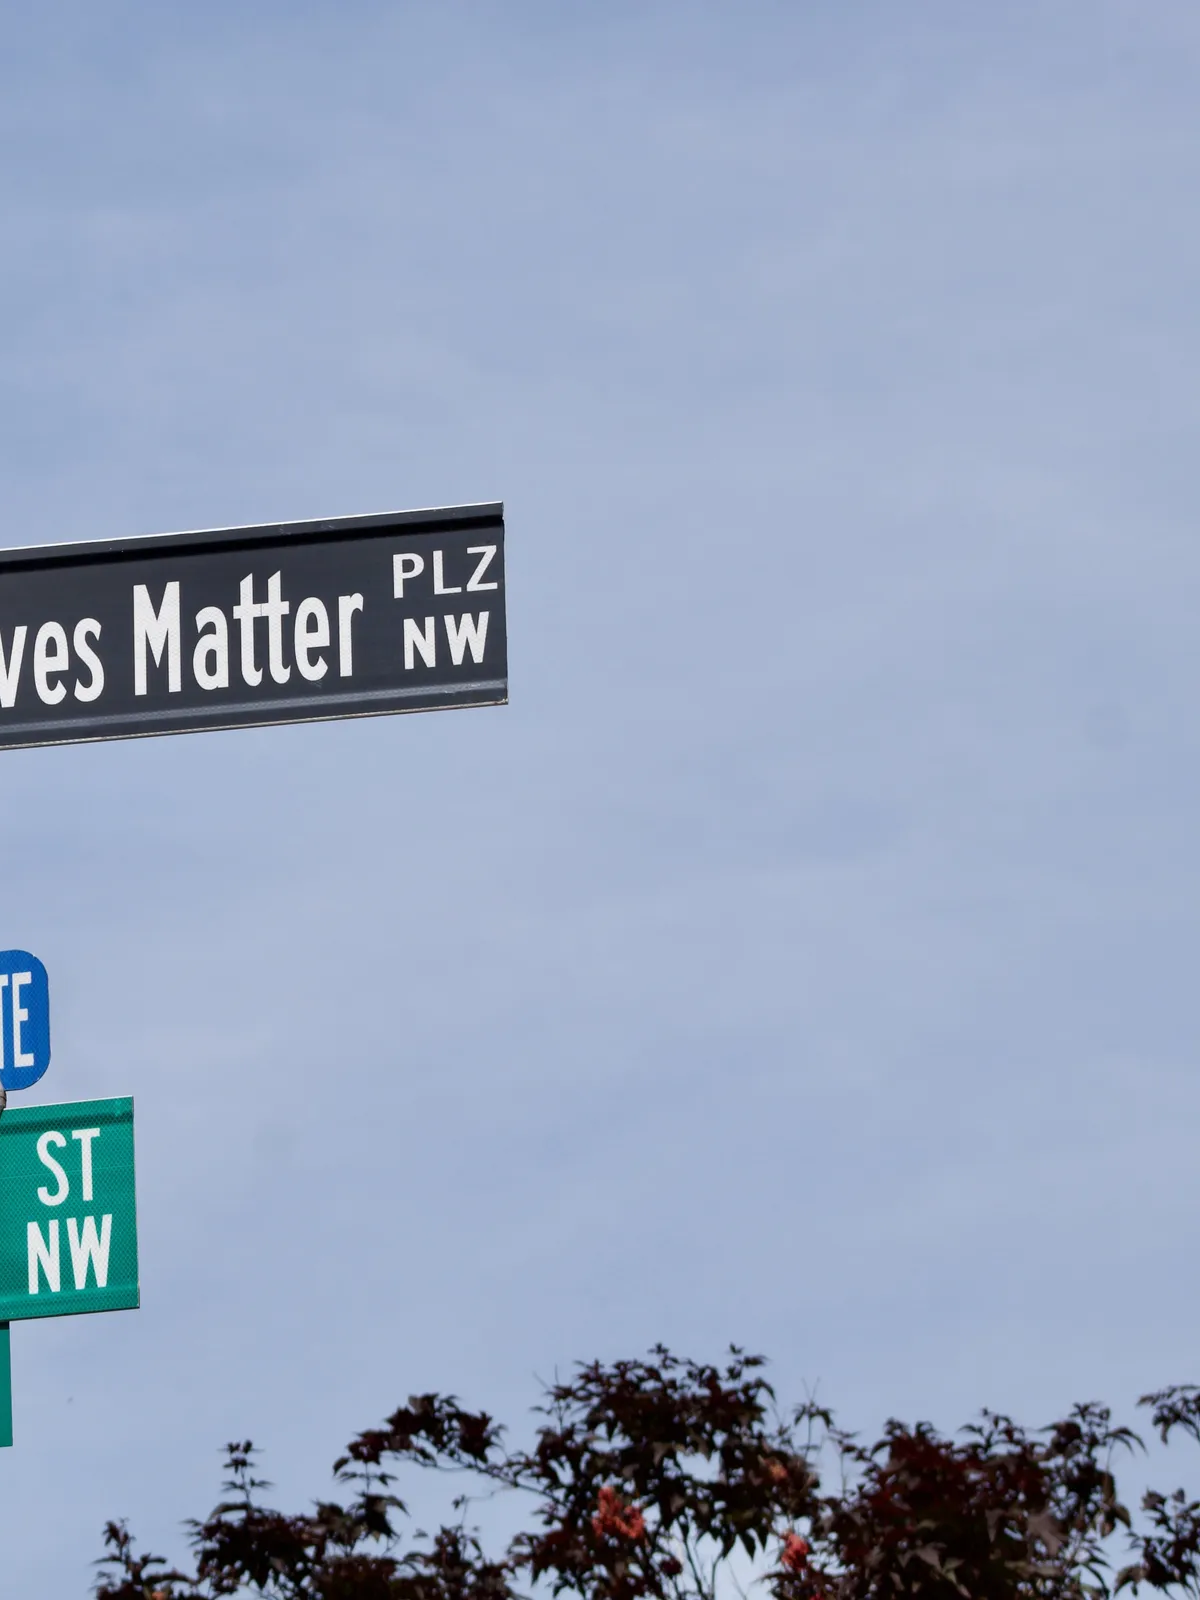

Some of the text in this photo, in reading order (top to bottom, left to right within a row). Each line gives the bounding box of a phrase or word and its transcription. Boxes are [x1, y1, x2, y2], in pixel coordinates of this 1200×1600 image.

[393, 545, 498, 599] PLZ
[133, 570, 363, 696] Matter
[403, 611, 490, 670] NW
[36, 1128, 101, 1206] ST
[27, 1214, 113, 1295] NW
